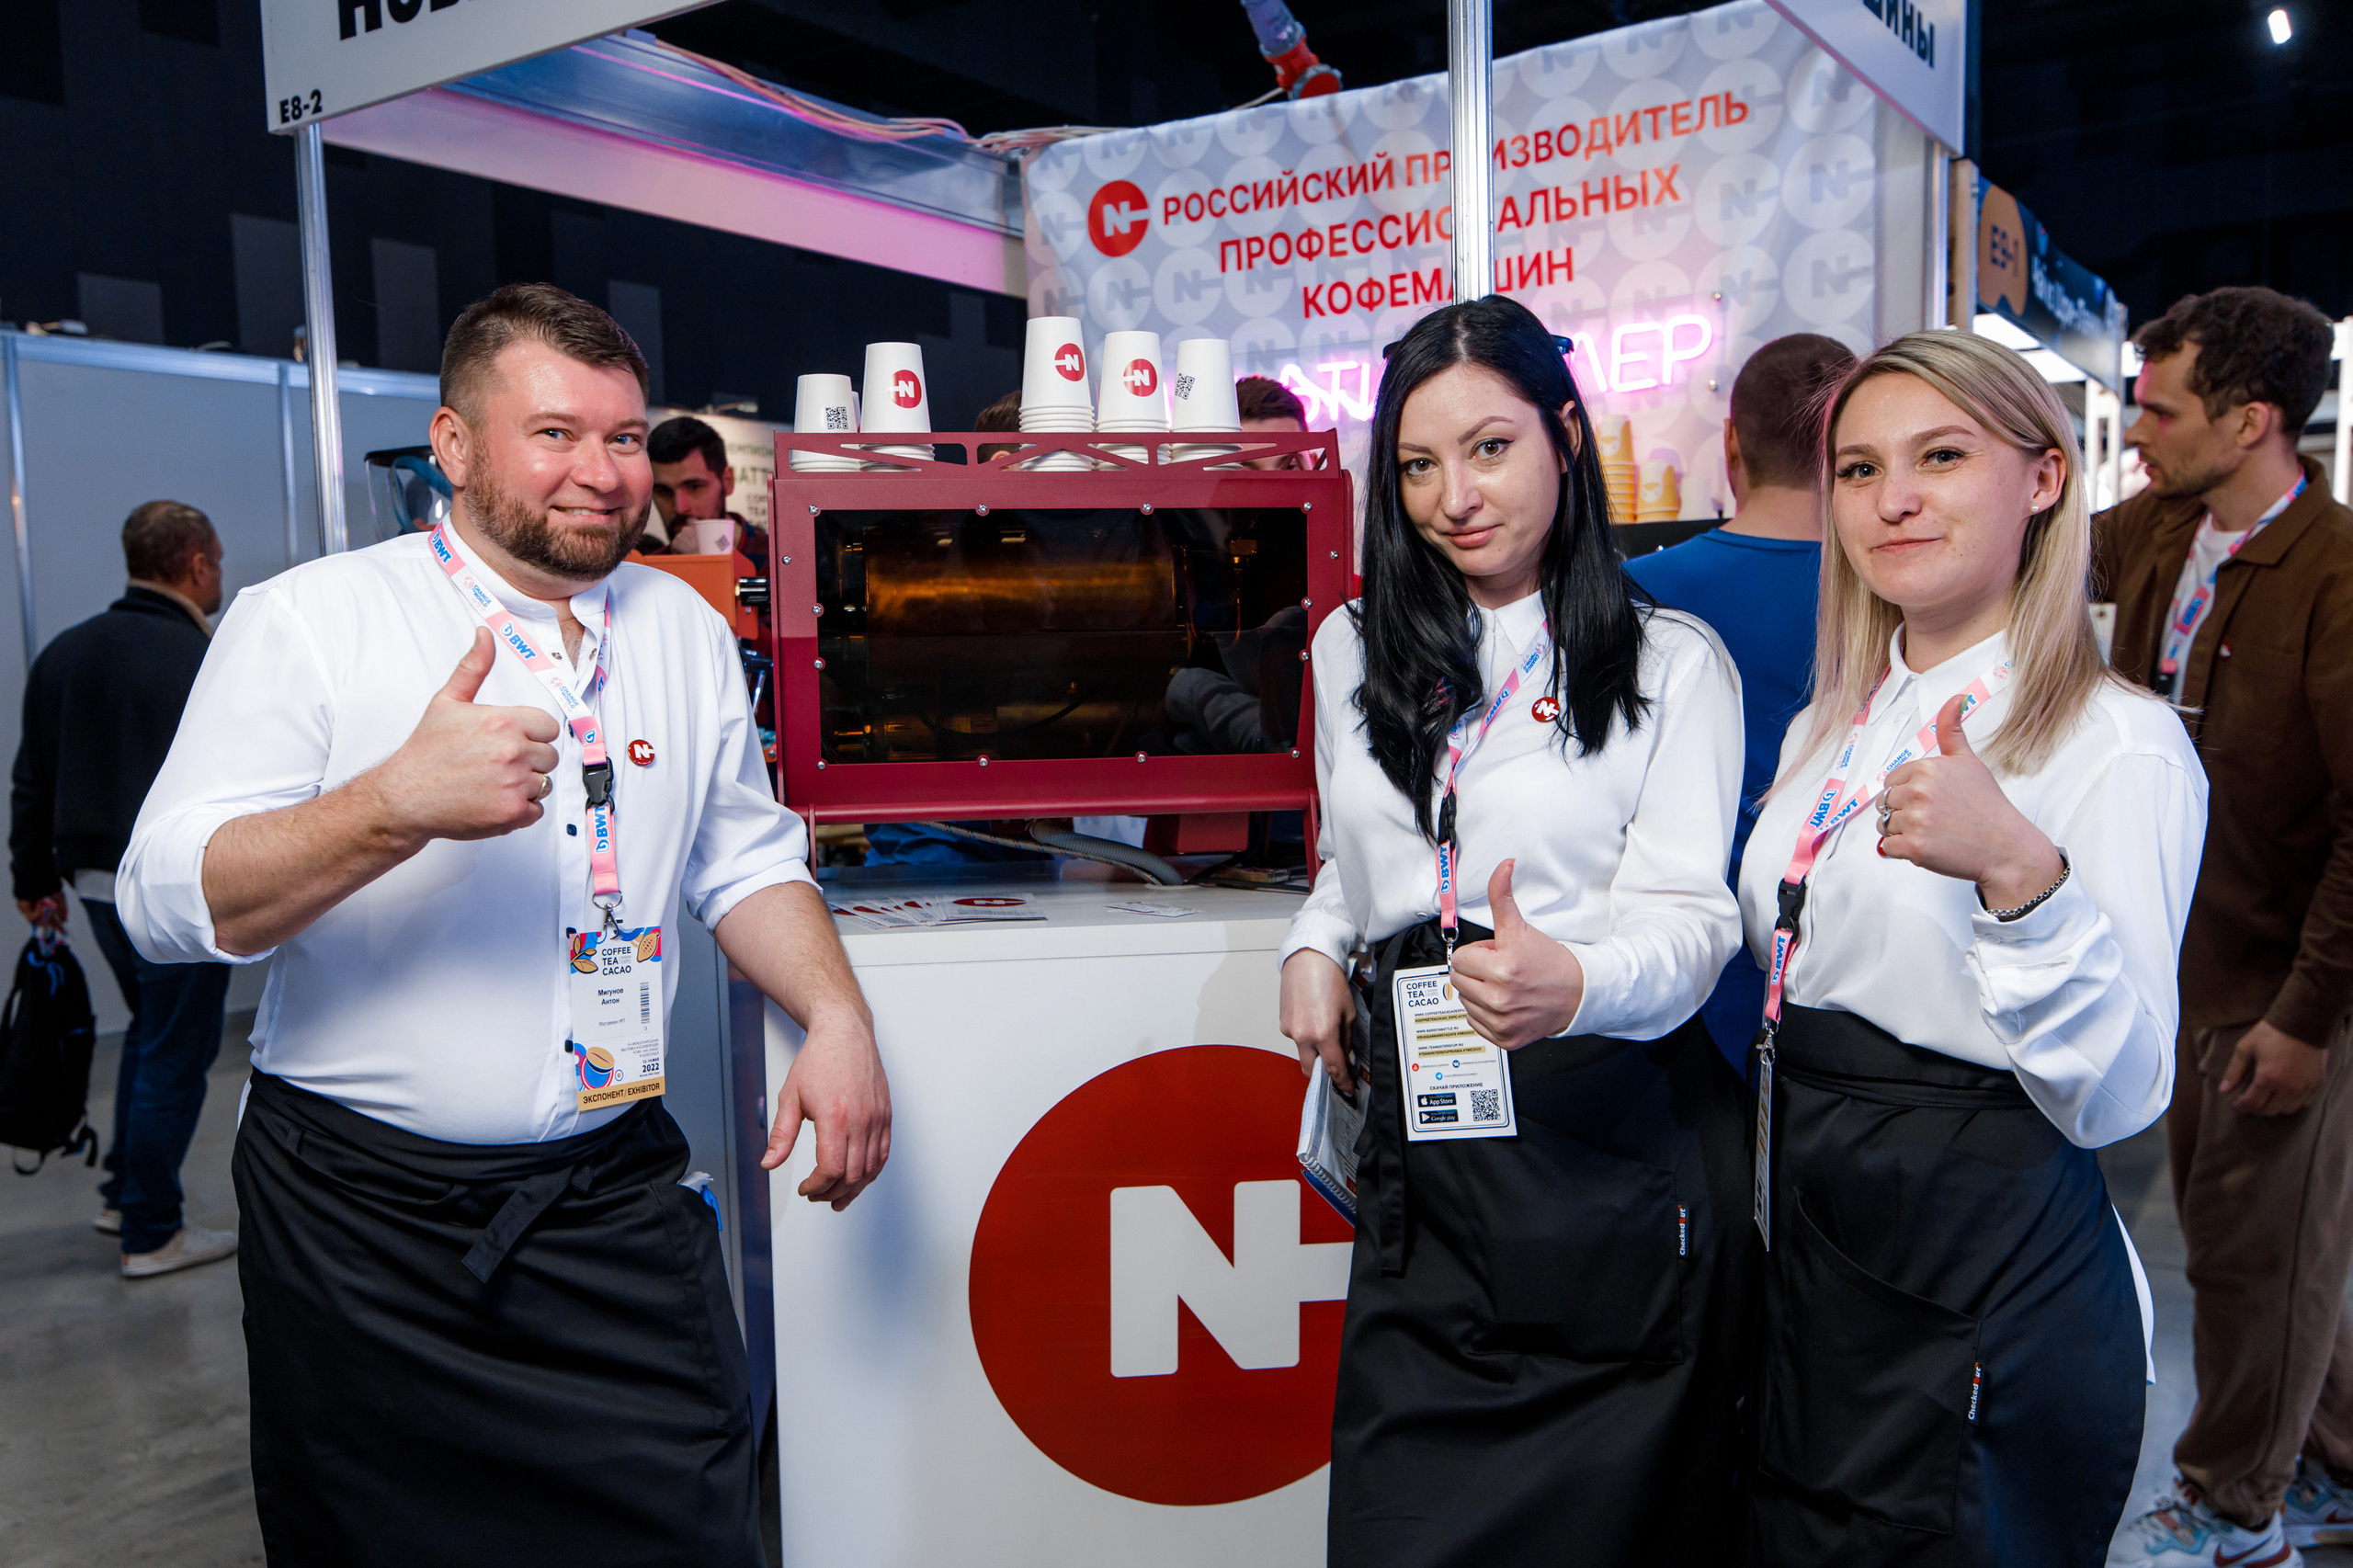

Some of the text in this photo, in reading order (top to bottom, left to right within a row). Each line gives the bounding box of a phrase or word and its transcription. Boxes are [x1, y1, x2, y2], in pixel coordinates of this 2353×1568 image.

[279, 88, 323, 125] E8-2
[1163, 91, 1750, 226] РОССИЙСКИЙ ПРИЗВОДИТЕЛЬ
[1220, 164, 1681, 274] ПРОФЕССИОАЛЬНЫХ
[1303, 246, 1574, 319] КОФЕМШИН
[434, 539, 452, 563] BWT
[473, 585, 492, 605] CHANGE
[508, 633, 537, 659] BWT
[562, 686, 579, 706] CHANGE
[1886, 748, 1910, 770] CHANGE
[1809, 802, 1831, 828] BWT
[1830, 798, 1859, 824] BWT
[1439, 846, 1449, 878] BWT
[601, 946, 631, 957] COFFEE
[602, 957, 619, 966] TEA
[1775, 935, 1786, 970] BWT
[602, 965, 632, 976] CACAO
[597, 988, 624, 997] Мигунов
[1406, 980, 1438, 990] COFFEE
[1407, 990, 1425, 998] TEA
[600, 998, 620, 1006] Антон
[1408, 997, 1439, 1007] CACAO
[642, 1062, 660, 1073] 2022
[583, 1089, 624, 1104] ЭКСПОНЕНТ
[628, 1082, 660, 1096] EXHIBITOR
[1431, 1114, 1446, 1122] Google
